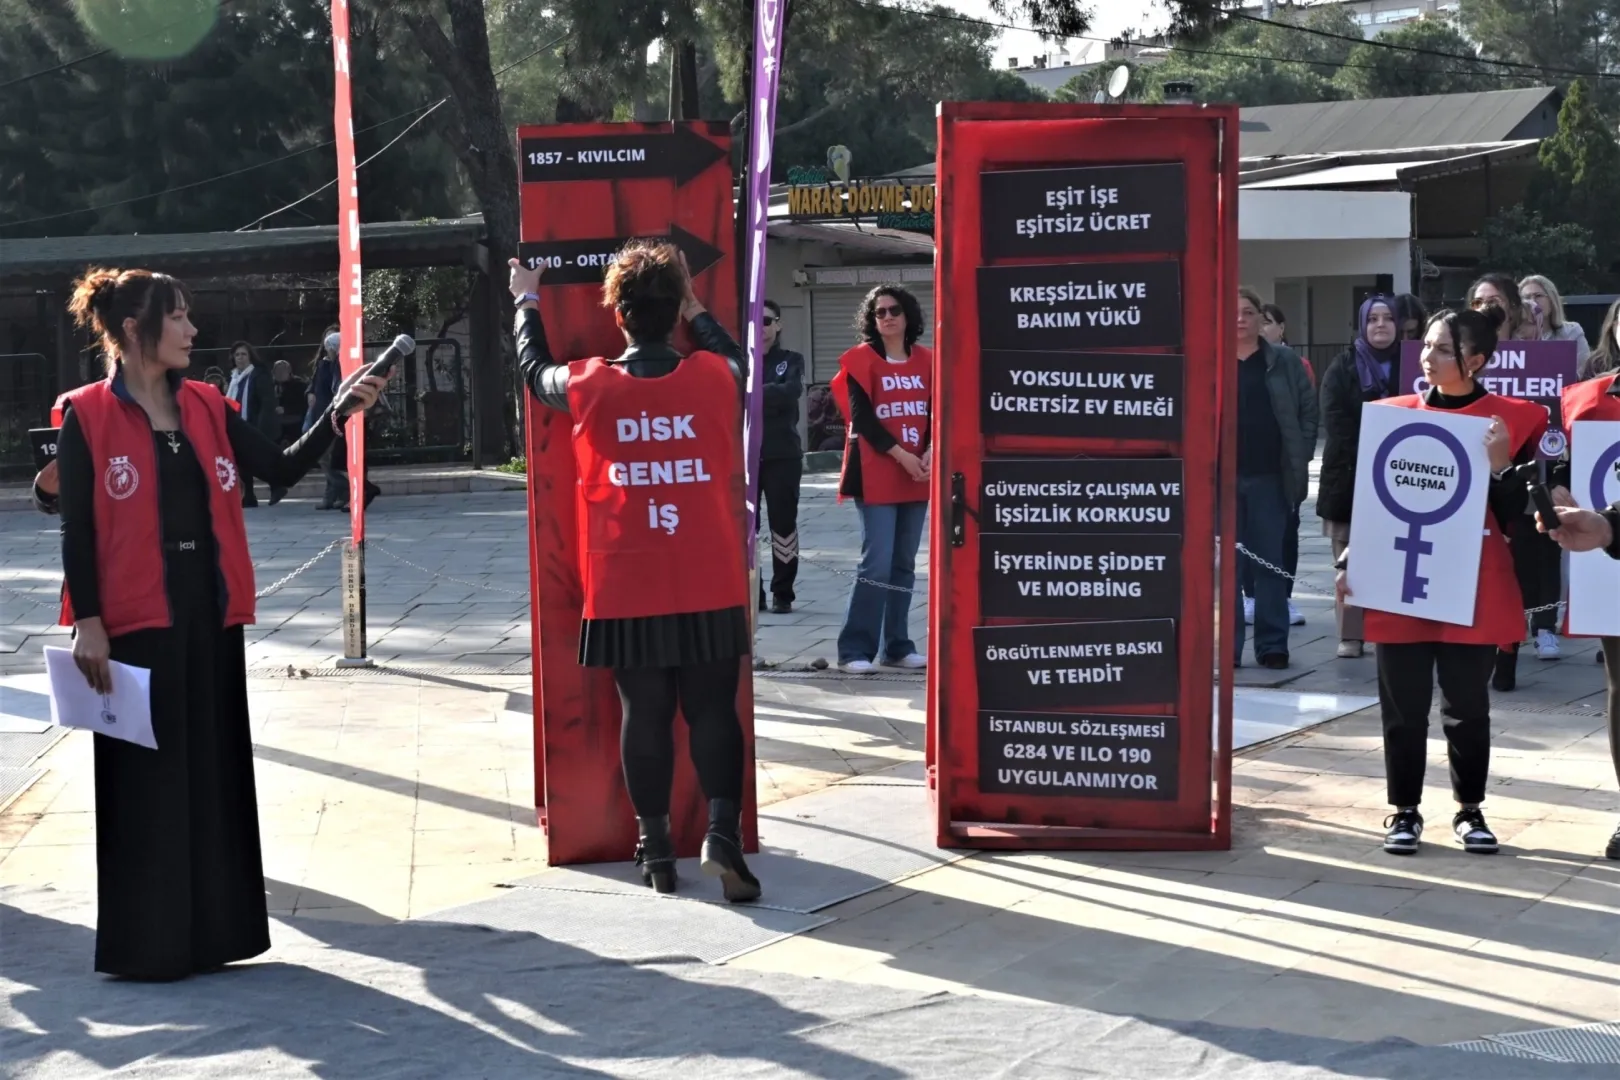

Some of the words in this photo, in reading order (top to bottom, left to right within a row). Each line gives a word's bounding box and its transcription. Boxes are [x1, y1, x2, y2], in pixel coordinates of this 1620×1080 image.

[528, 152, 562, 165] 1857
[577, 148, 645, 164] KIVILCIM
[788, 186, 843, 217] MARAŞ
[848, 183, 905, 213] DÖVME
[910, 184, 935, 213] DO
[1045, 186, 1085, 210] EŞİT
[1090, 185, 1118, 208] İŞE
[1016, 213, 1084, 238] EŞİTSİZ
[1089, 212, 1151, 232] ÜCRET
[577, 253, 618, 267] ORTA
[1010, 280, 1117, 305] KREŞSİZLİK
[1121, 282, 1146, 299] VE
[1017, 311, 1081, 328] BAKIM
[1085, 306, 1140, 326] YÜKÜ
[1484, 350, 1526, 370] DIN
[881, 372, 925, 391] DİSK
[1009, 370, 1125, 389] YOKSULLUK
[1129, 373, 1154, 390] VE
[1413, 374, 1564, 397] CETLERİ
[990, 392, 1079, 414] ÜCRETSİZ
[1085, 398, 1108, 415] EV
[1113, 396, 1174, 417] EMEĞİ
[616, 410, 697, 443] DİSK
[901, 424, 920, 447] İŞ
[40, 443, 57, 456] 19
[608, 458, 712, 487] GENEL
[1390, 458, 1455, 478] GÜVENCELİ
[985, 480, 1082, 496] GÜVENCESİZ
[1085, 482, 1157, 499] ÇALIŞMA
[1160, 482, 1180, 496] VE
[1394, 474, 1446, 491] ÇALIŞMA
[648, 498, 680, 535] İŞ
[995, 503, 1072, 527] İŞSİZLİK
[1077, 506, 1171, 523] KORKUSU
[994, 550, 1093, 574] İŞYERİNDE
[1098, 551, 1166, 575] ŞİDDET
[1017, 581, 1041, 597] VE
[1047, 577, 1142, 598] MOBBİNG
[985, 643, 1112, 661] ÖRGÜTLENMEYE
[1116, 641, 1163, 656] BASKI
[1027, 669, 1051, 685] VE
[1056, 663, 1124, 684] TEHDİT
[989, 716, 1067, 735] İSTANBUL
[1070, 720, 1165, 740] SÖZLEŞMESİ
[1003, 743, 1047, 760] 6284
[1052, 744, 1075, 761] VE
[1080, 746, 1112, 762] ILO
[1118, 747, 1151, 764] 190
[998, 768, 1158, 790] UYGULANMIYOR
